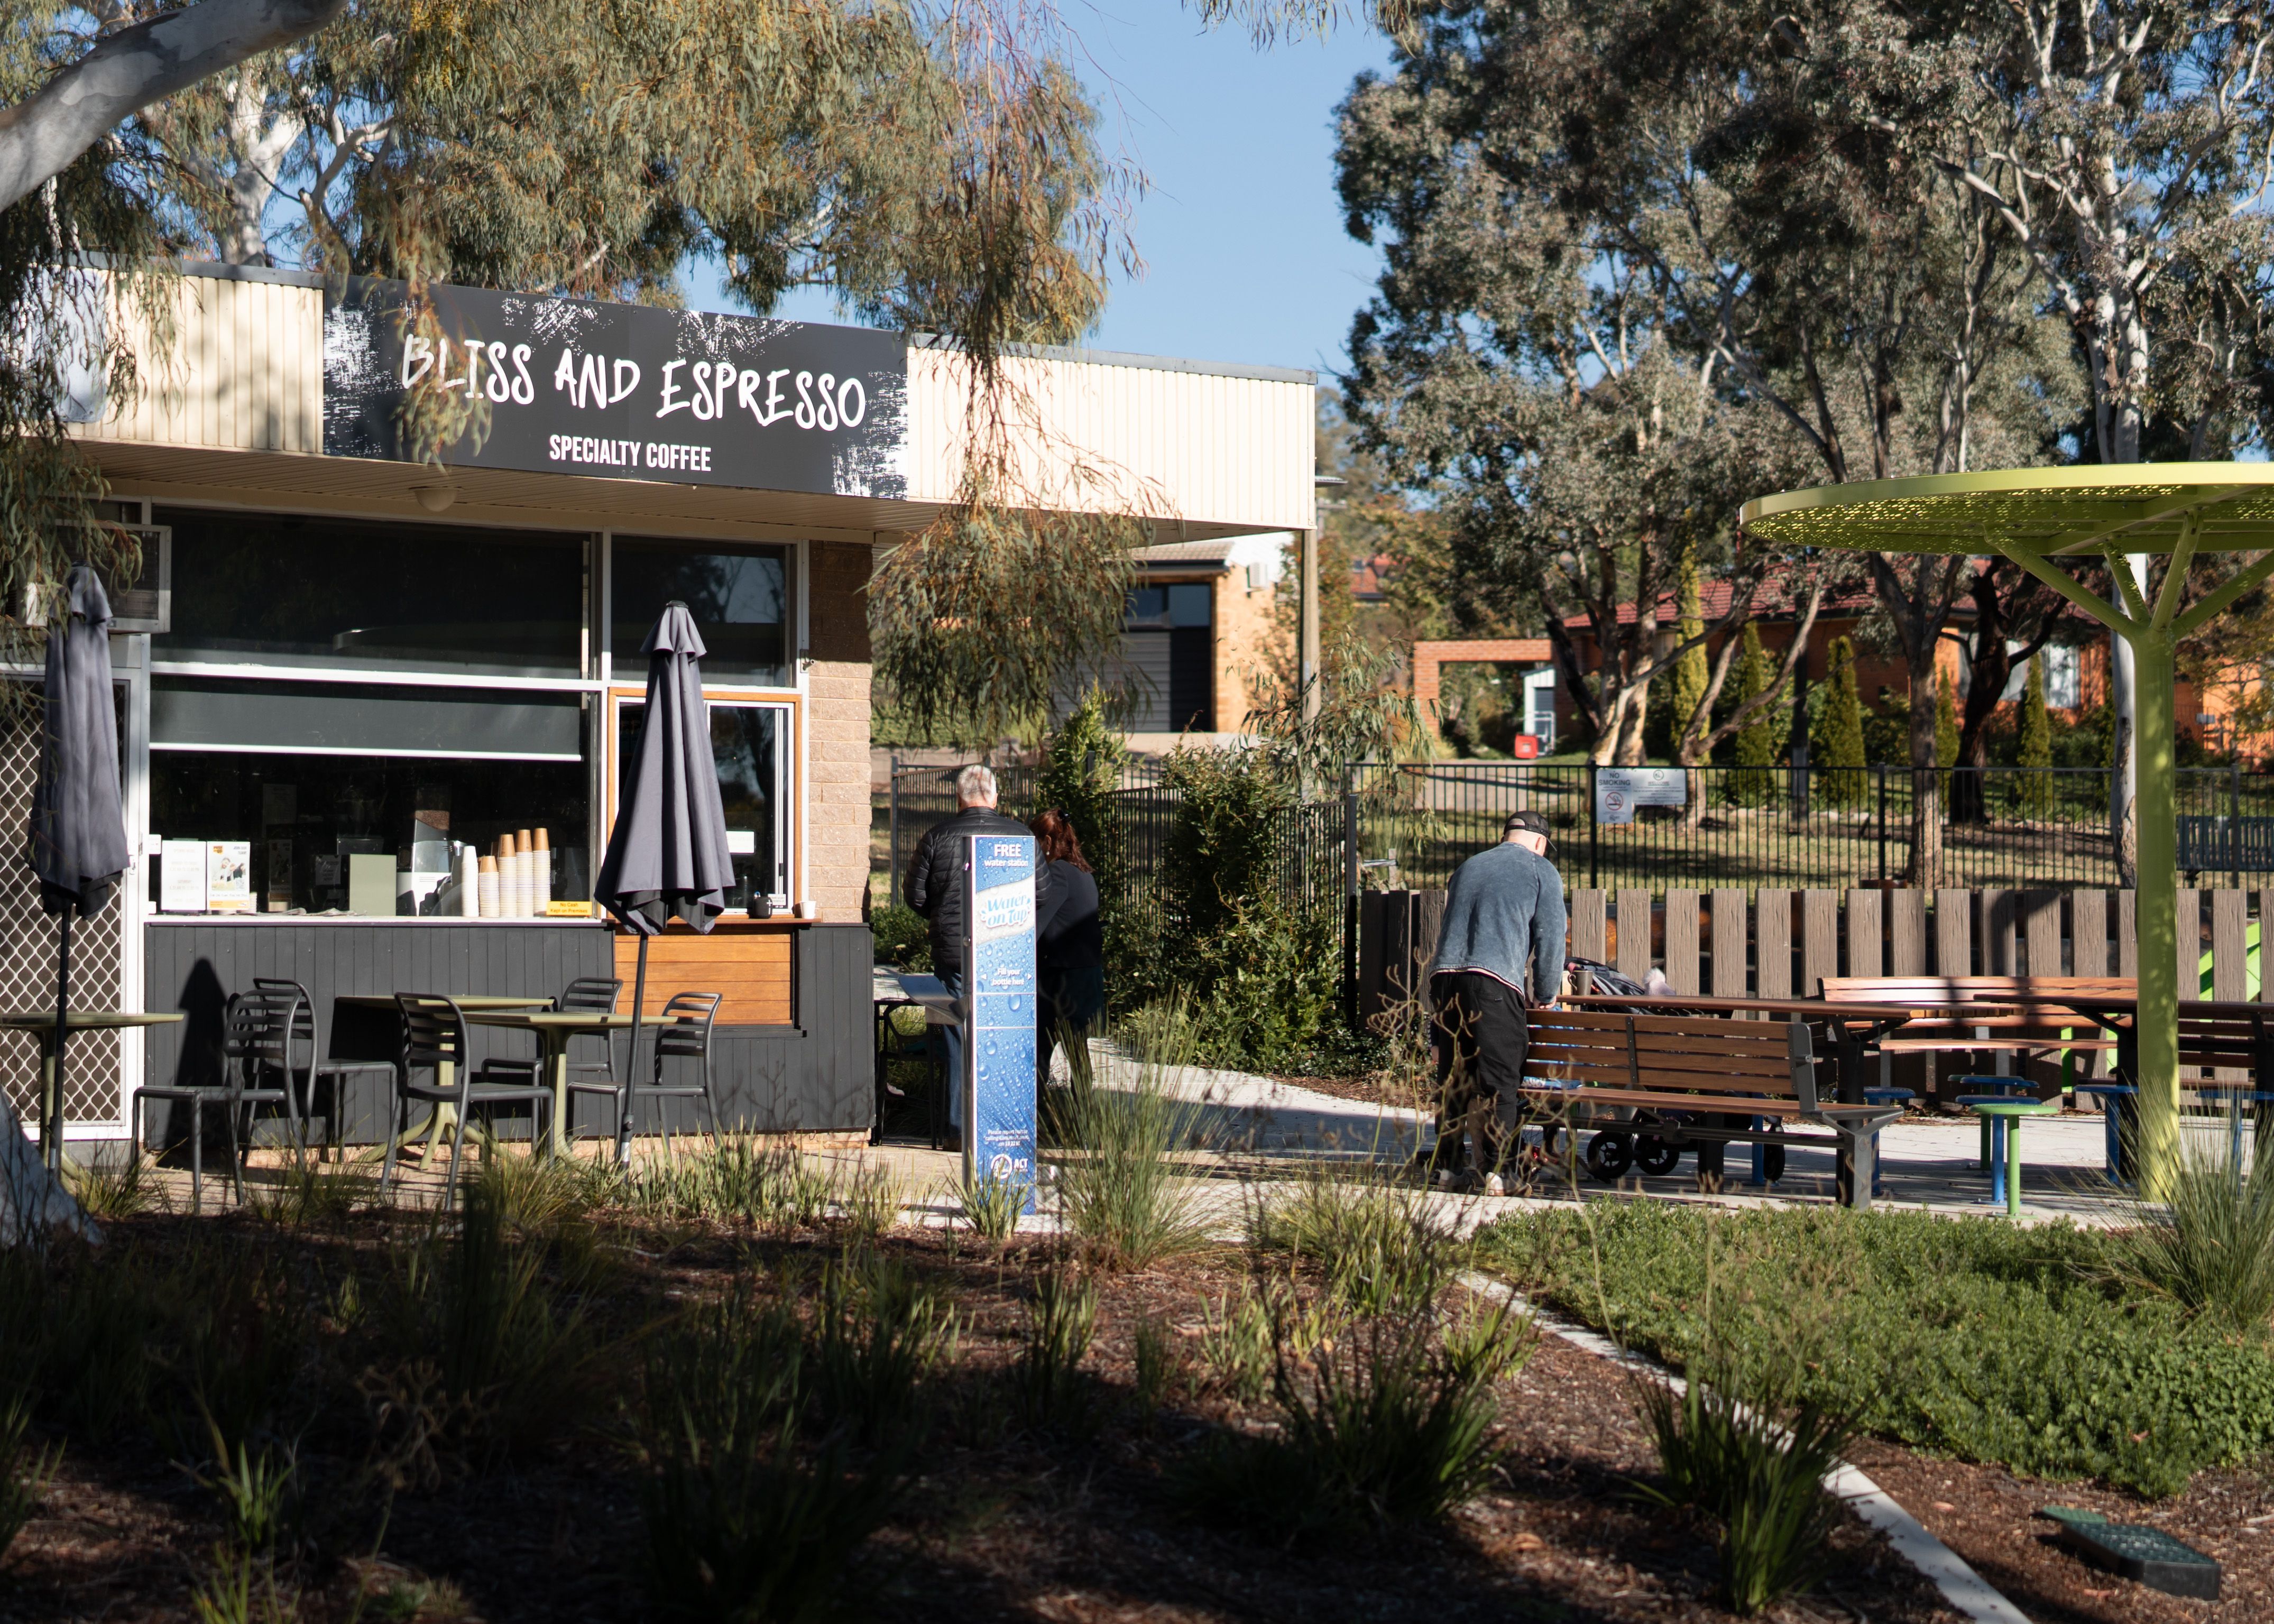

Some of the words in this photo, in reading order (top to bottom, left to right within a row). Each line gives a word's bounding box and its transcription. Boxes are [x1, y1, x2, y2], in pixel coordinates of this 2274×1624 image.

[402, 334, 535, 404] BLISS
[555, 348, 641, 409] AND
[656, 359, 866, 431] ESPRESSO
[549, 434, 641, 466] SPECIALTY
[646, 442, 711, 472] COFFEE
[994, 844, 1021, 857] FREE
[988, 895, 1027, 911] Water
[987, 912, 1006, 926] on
[1008, 909, 1027, 924] Tap
[1007, 969, 1020, 978] your
[1014, 1158, 1028, 1169] ACT
